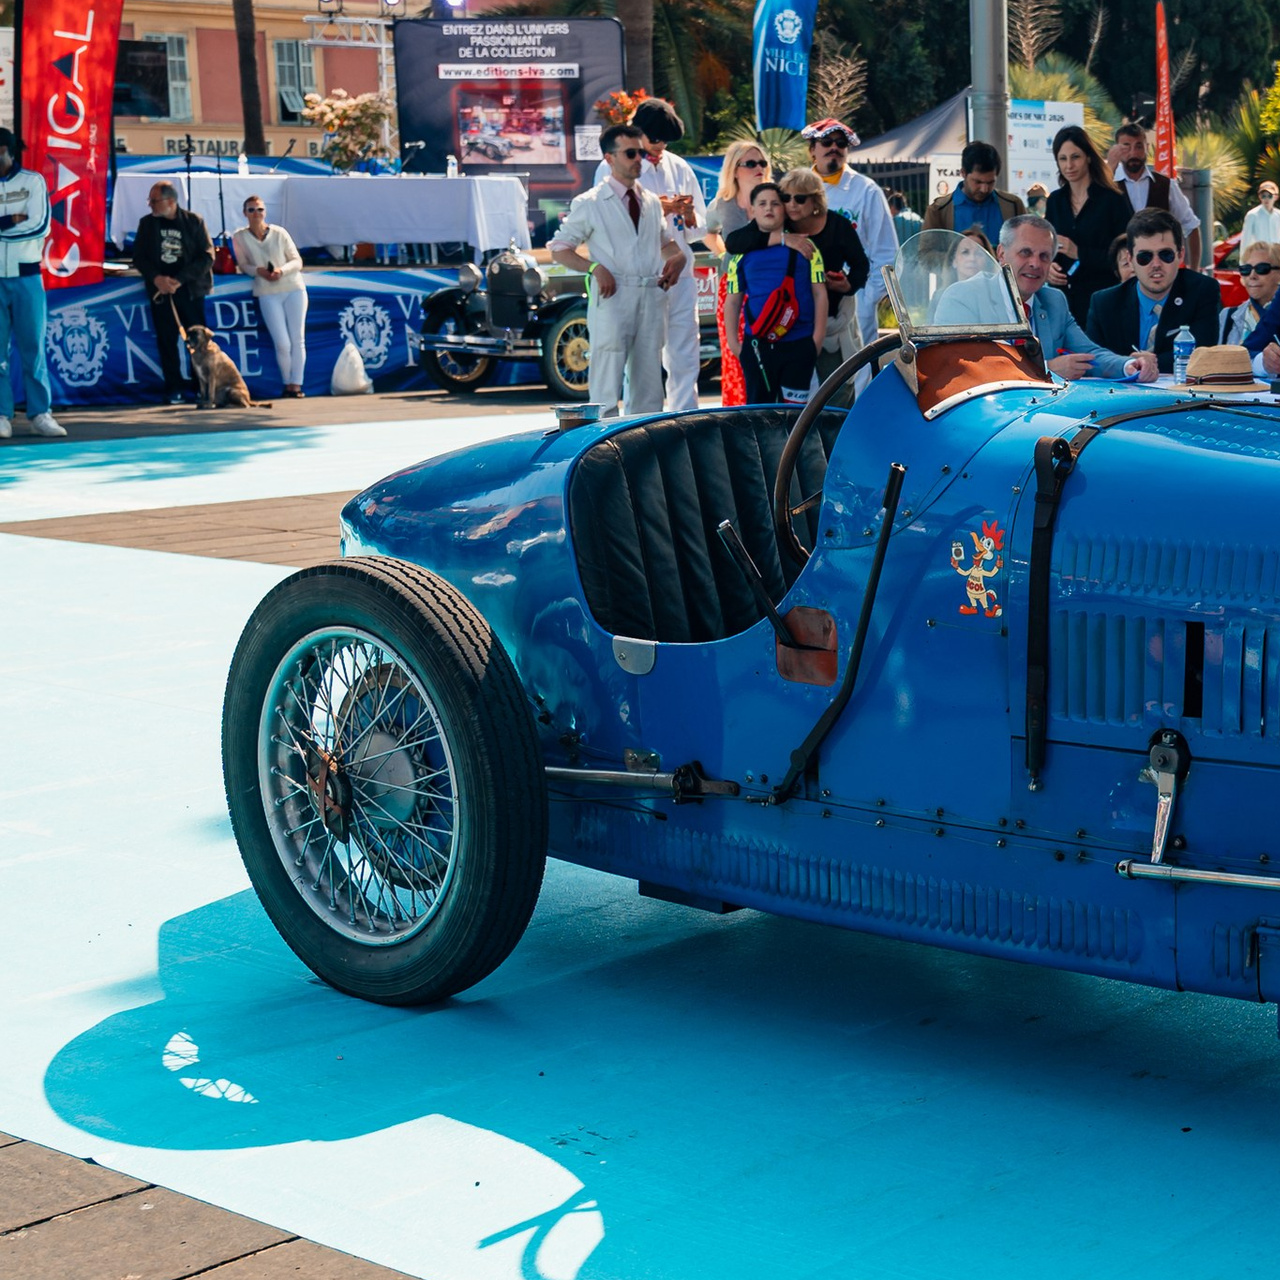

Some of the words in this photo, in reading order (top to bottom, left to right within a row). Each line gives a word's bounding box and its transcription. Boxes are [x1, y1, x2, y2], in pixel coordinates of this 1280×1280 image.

[442, 24, 484, 36] ENTREZ
[485, 24, 515, 35] DANS
[516, 23, 570, 35] L'UNIVERS
[470, 35, 542, 46] PASSIONNANT
[458, 46, 474, 58] DE
[475, 47, 489, 57] LA
[490, 46, 556, 58] COLLECTION
[765, 57, 809, 76] NICE
[45, 10, 95, 278] CAVIGAL
[166, 138, 272, 156] RESTAURT
[214, 299, 258, 330] DE
